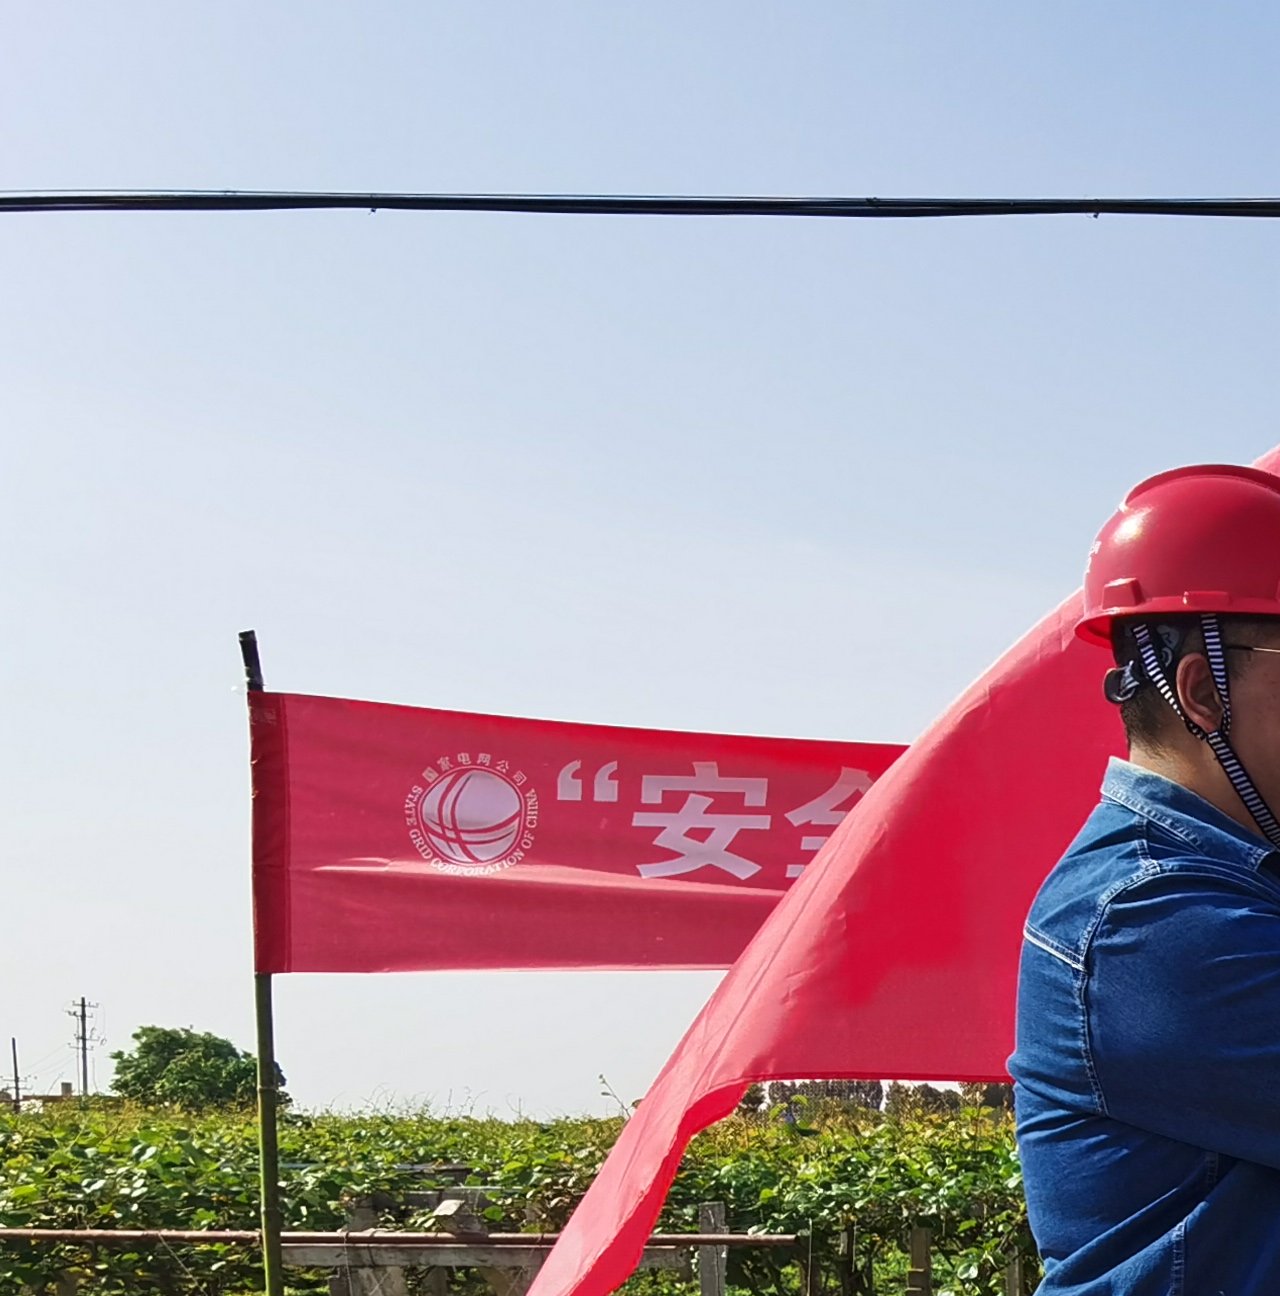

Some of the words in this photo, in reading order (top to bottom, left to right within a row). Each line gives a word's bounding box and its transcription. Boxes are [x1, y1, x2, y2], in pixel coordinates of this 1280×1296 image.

[422, 752, 527, 786] 国家电网公司
[404, 785, 423, 826] STATE
[524, 788, 538, 828] CHINA
[409, 828, 433, 859] GRID
[521, 830, 535, 849] OF
[430, 848, 525, 876] CORPORATION
